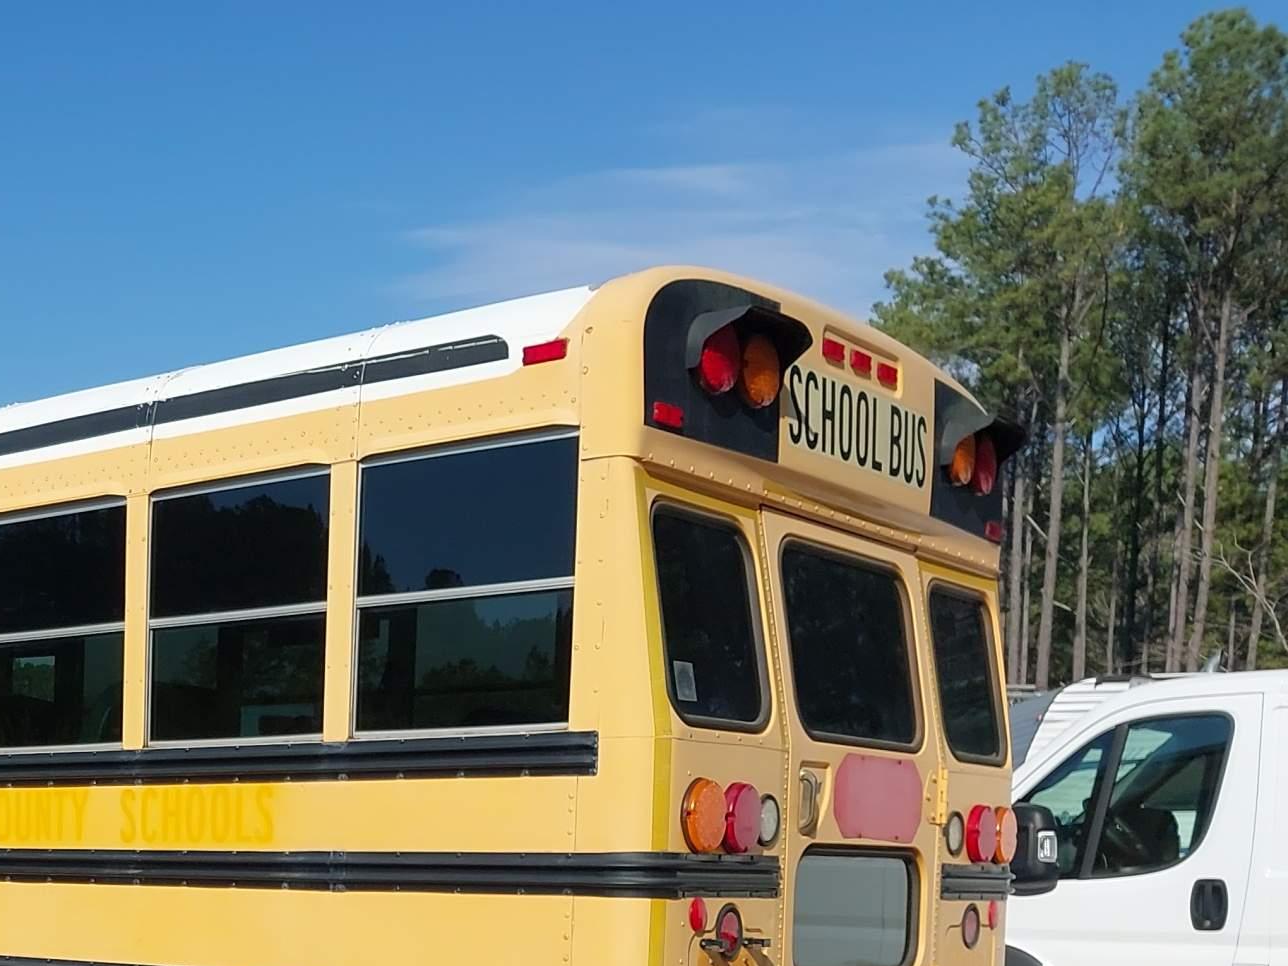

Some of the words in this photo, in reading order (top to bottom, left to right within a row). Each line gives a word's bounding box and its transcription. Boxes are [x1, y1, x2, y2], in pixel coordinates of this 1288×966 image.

[789, 365, 882, 471] SCHOOL
[889, 404, 927, 488] BUS
[120, 787, 275, 844] SCHOOLS
